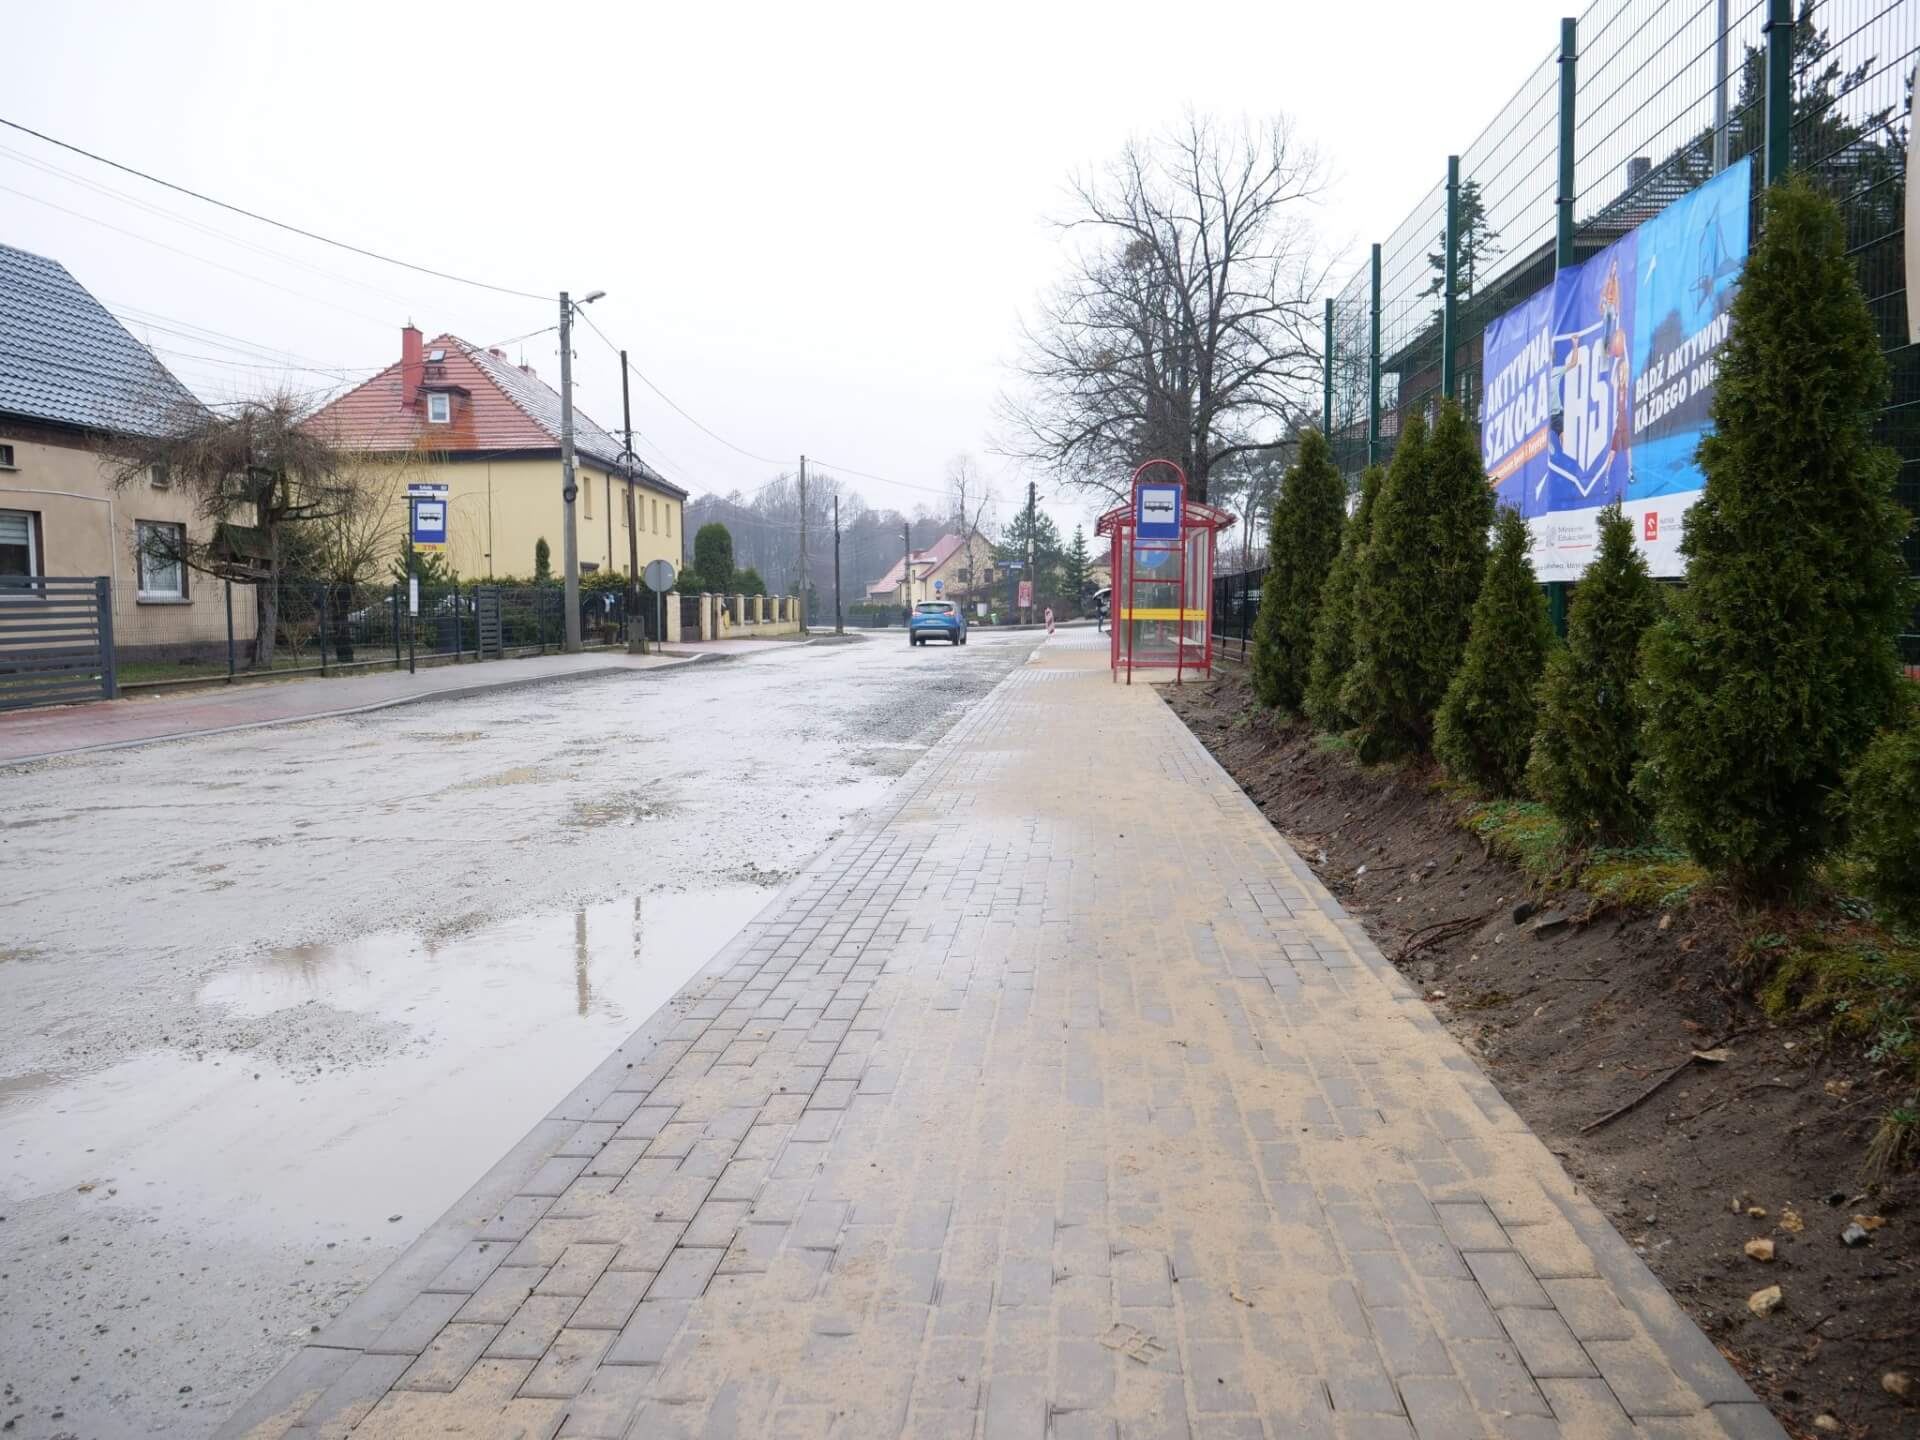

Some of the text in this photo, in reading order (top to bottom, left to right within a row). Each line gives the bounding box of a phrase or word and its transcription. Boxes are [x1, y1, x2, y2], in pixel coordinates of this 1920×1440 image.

[1486, 325, 1549, 421] AKTYWNA
[1562, 338, 1609, 473] AS
[1633, 377, 1688, 434] KAŻDEGO
[1635, 312, 1730, 403] BĄDŹ AKTYWNY
[1484, 371, 1549, 470] SZKOŁA
